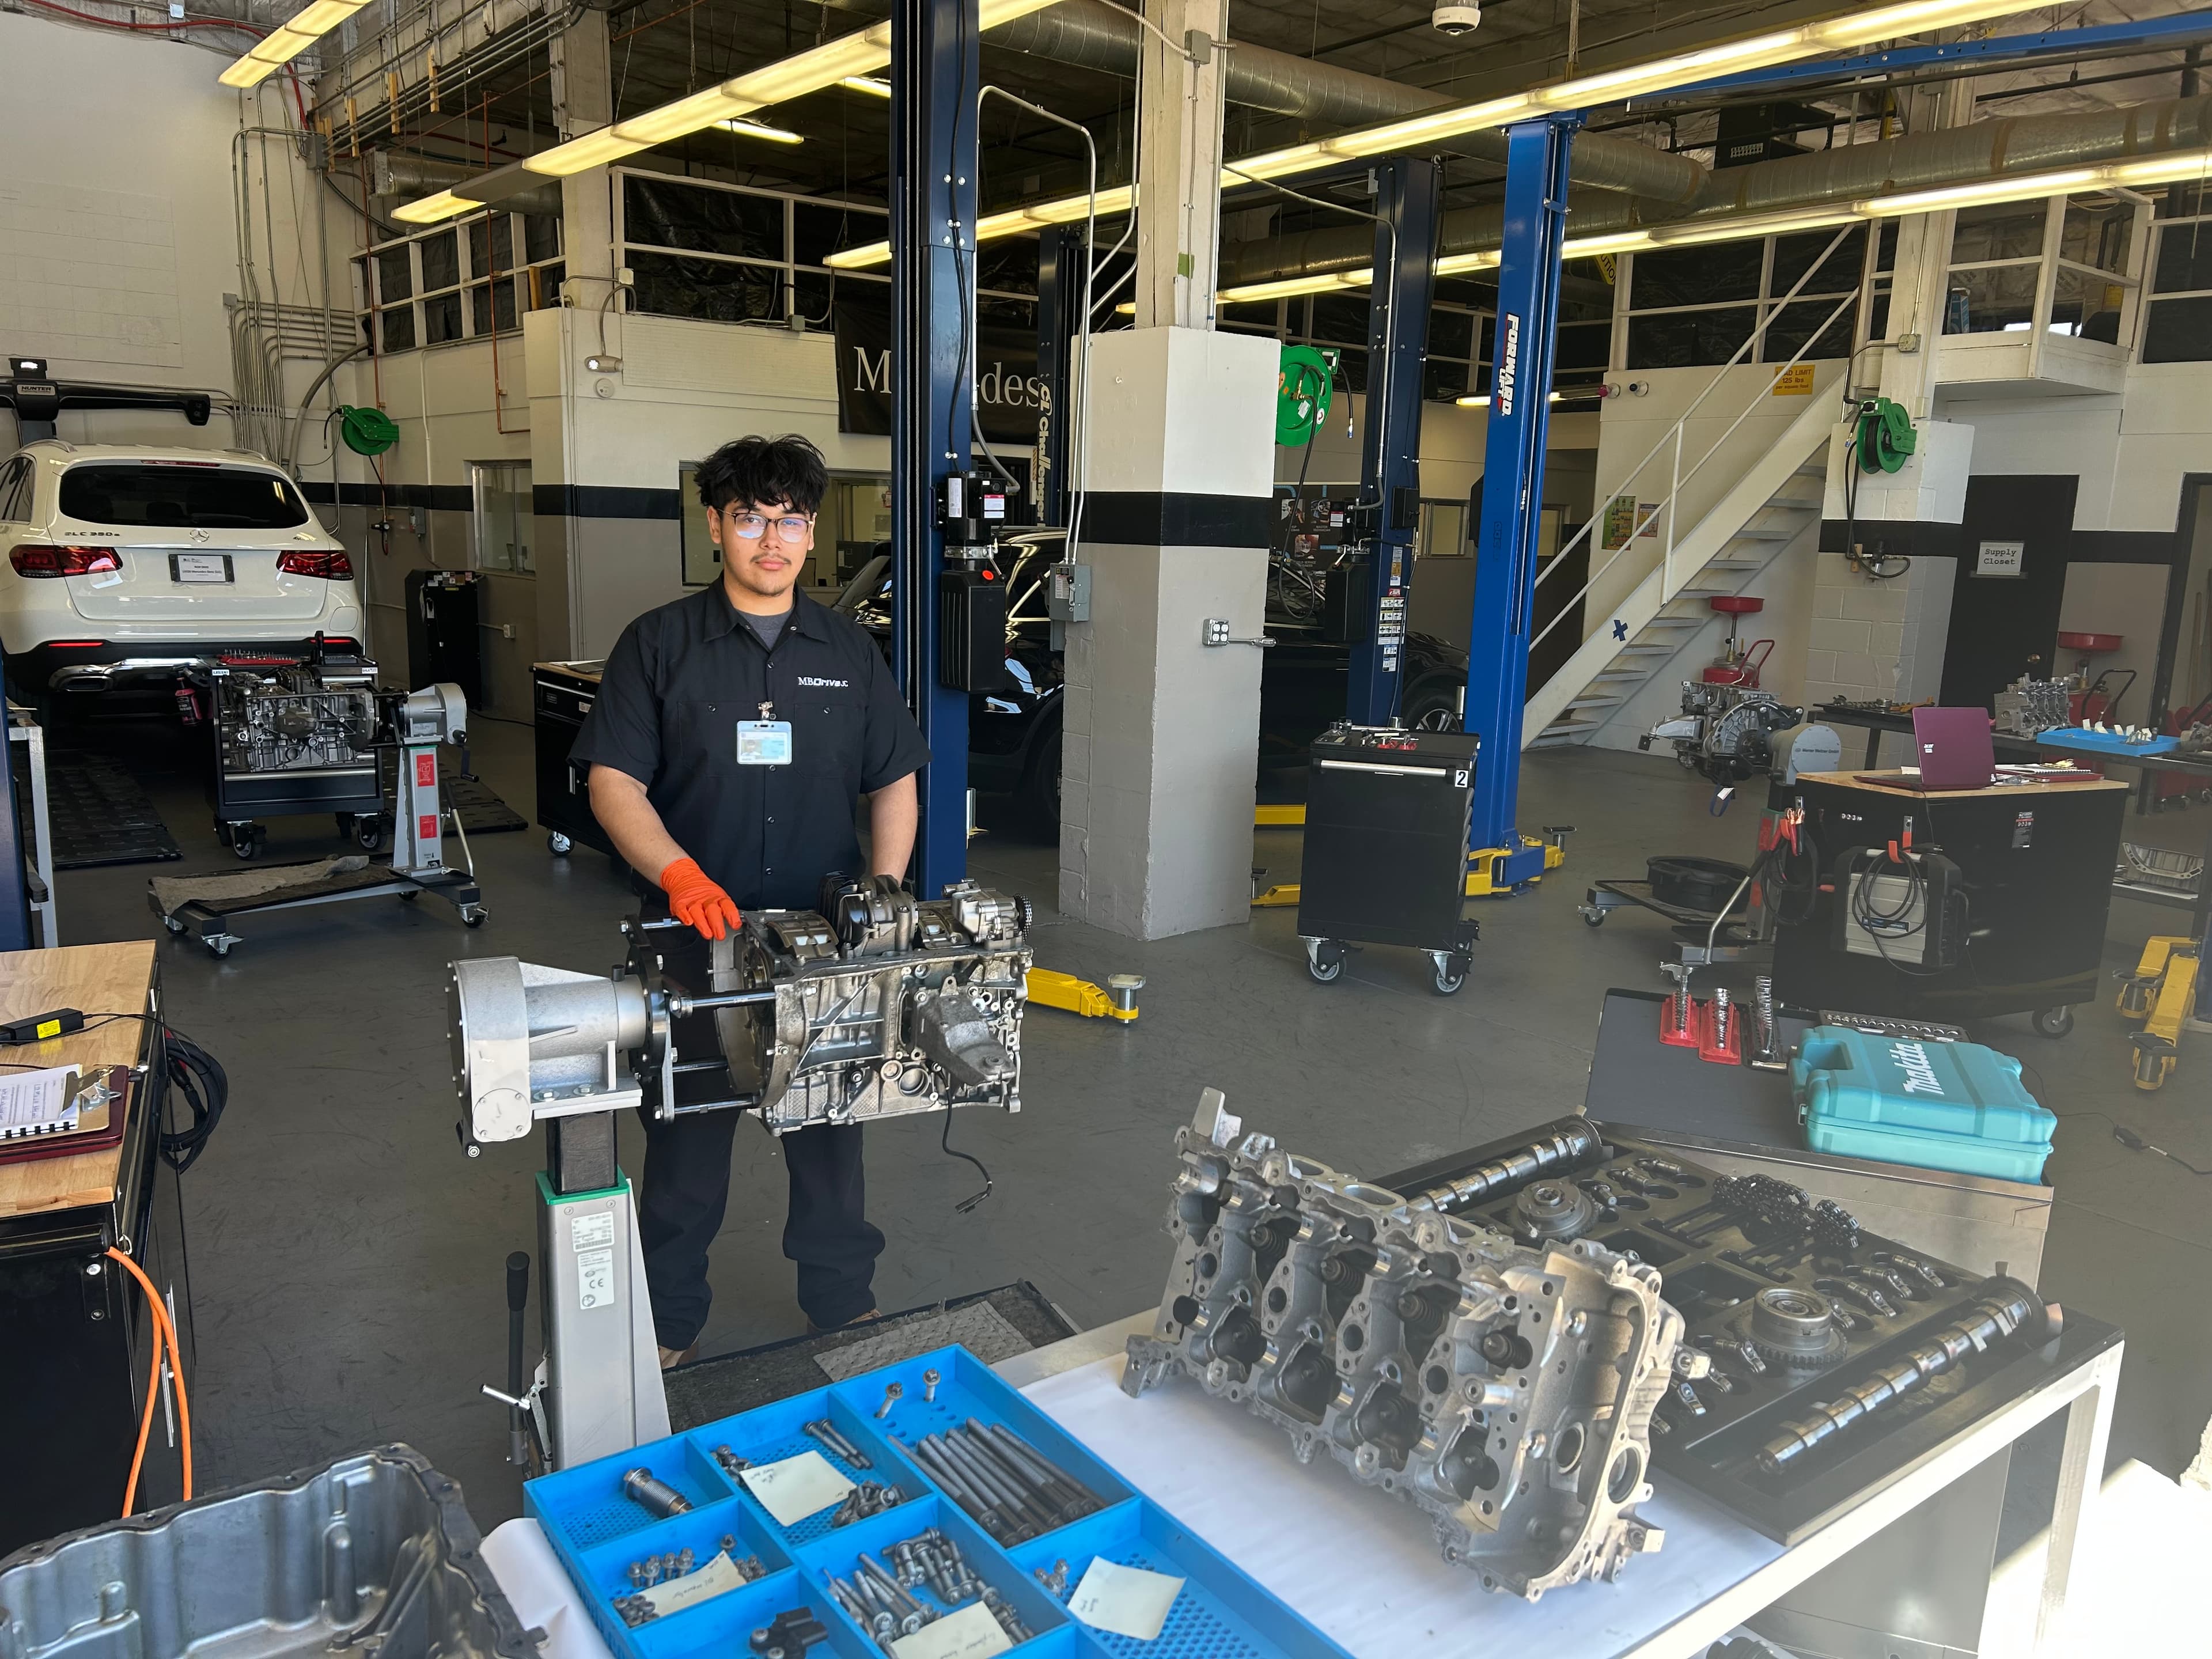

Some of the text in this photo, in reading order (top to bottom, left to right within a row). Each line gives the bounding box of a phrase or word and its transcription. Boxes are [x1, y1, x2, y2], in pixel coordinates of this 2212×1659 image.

[1502, 314, 1520, 415] FORWARD
[1498, 368, 1506, 397] LIFT
[1037, 416, 1051, 521] Challenger
[1984, 548, 2017, 557] Supply
[1457, 771, 1466, 786] 2
